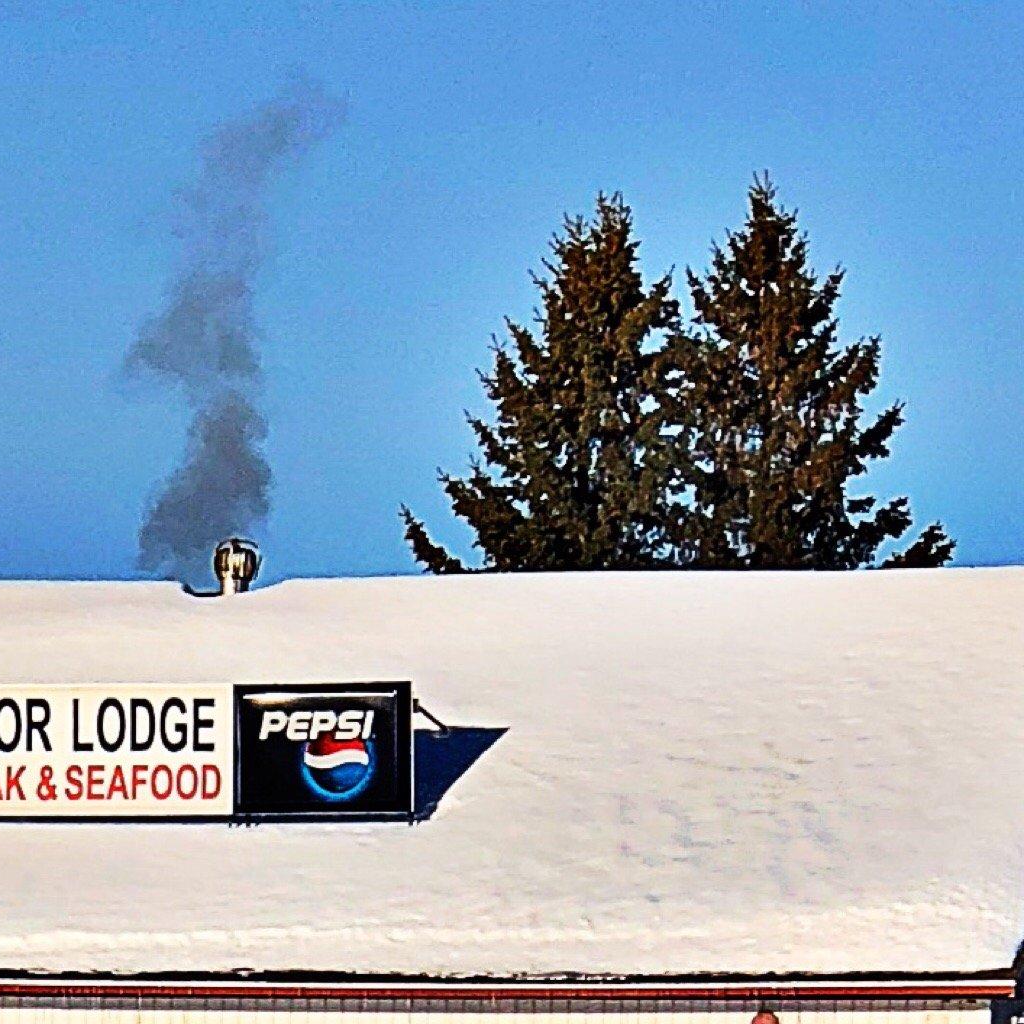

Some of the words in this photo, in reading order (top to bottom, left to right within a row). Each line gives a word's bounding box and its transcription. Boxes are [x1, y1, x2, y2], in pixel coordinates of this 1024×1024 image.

[73, 697, 215, 752] LODGE
[259, 710, 374, 740] PEPSI
[36, 765, 57, 801] &
[65, 764, 221, 800] SEAFOOD
